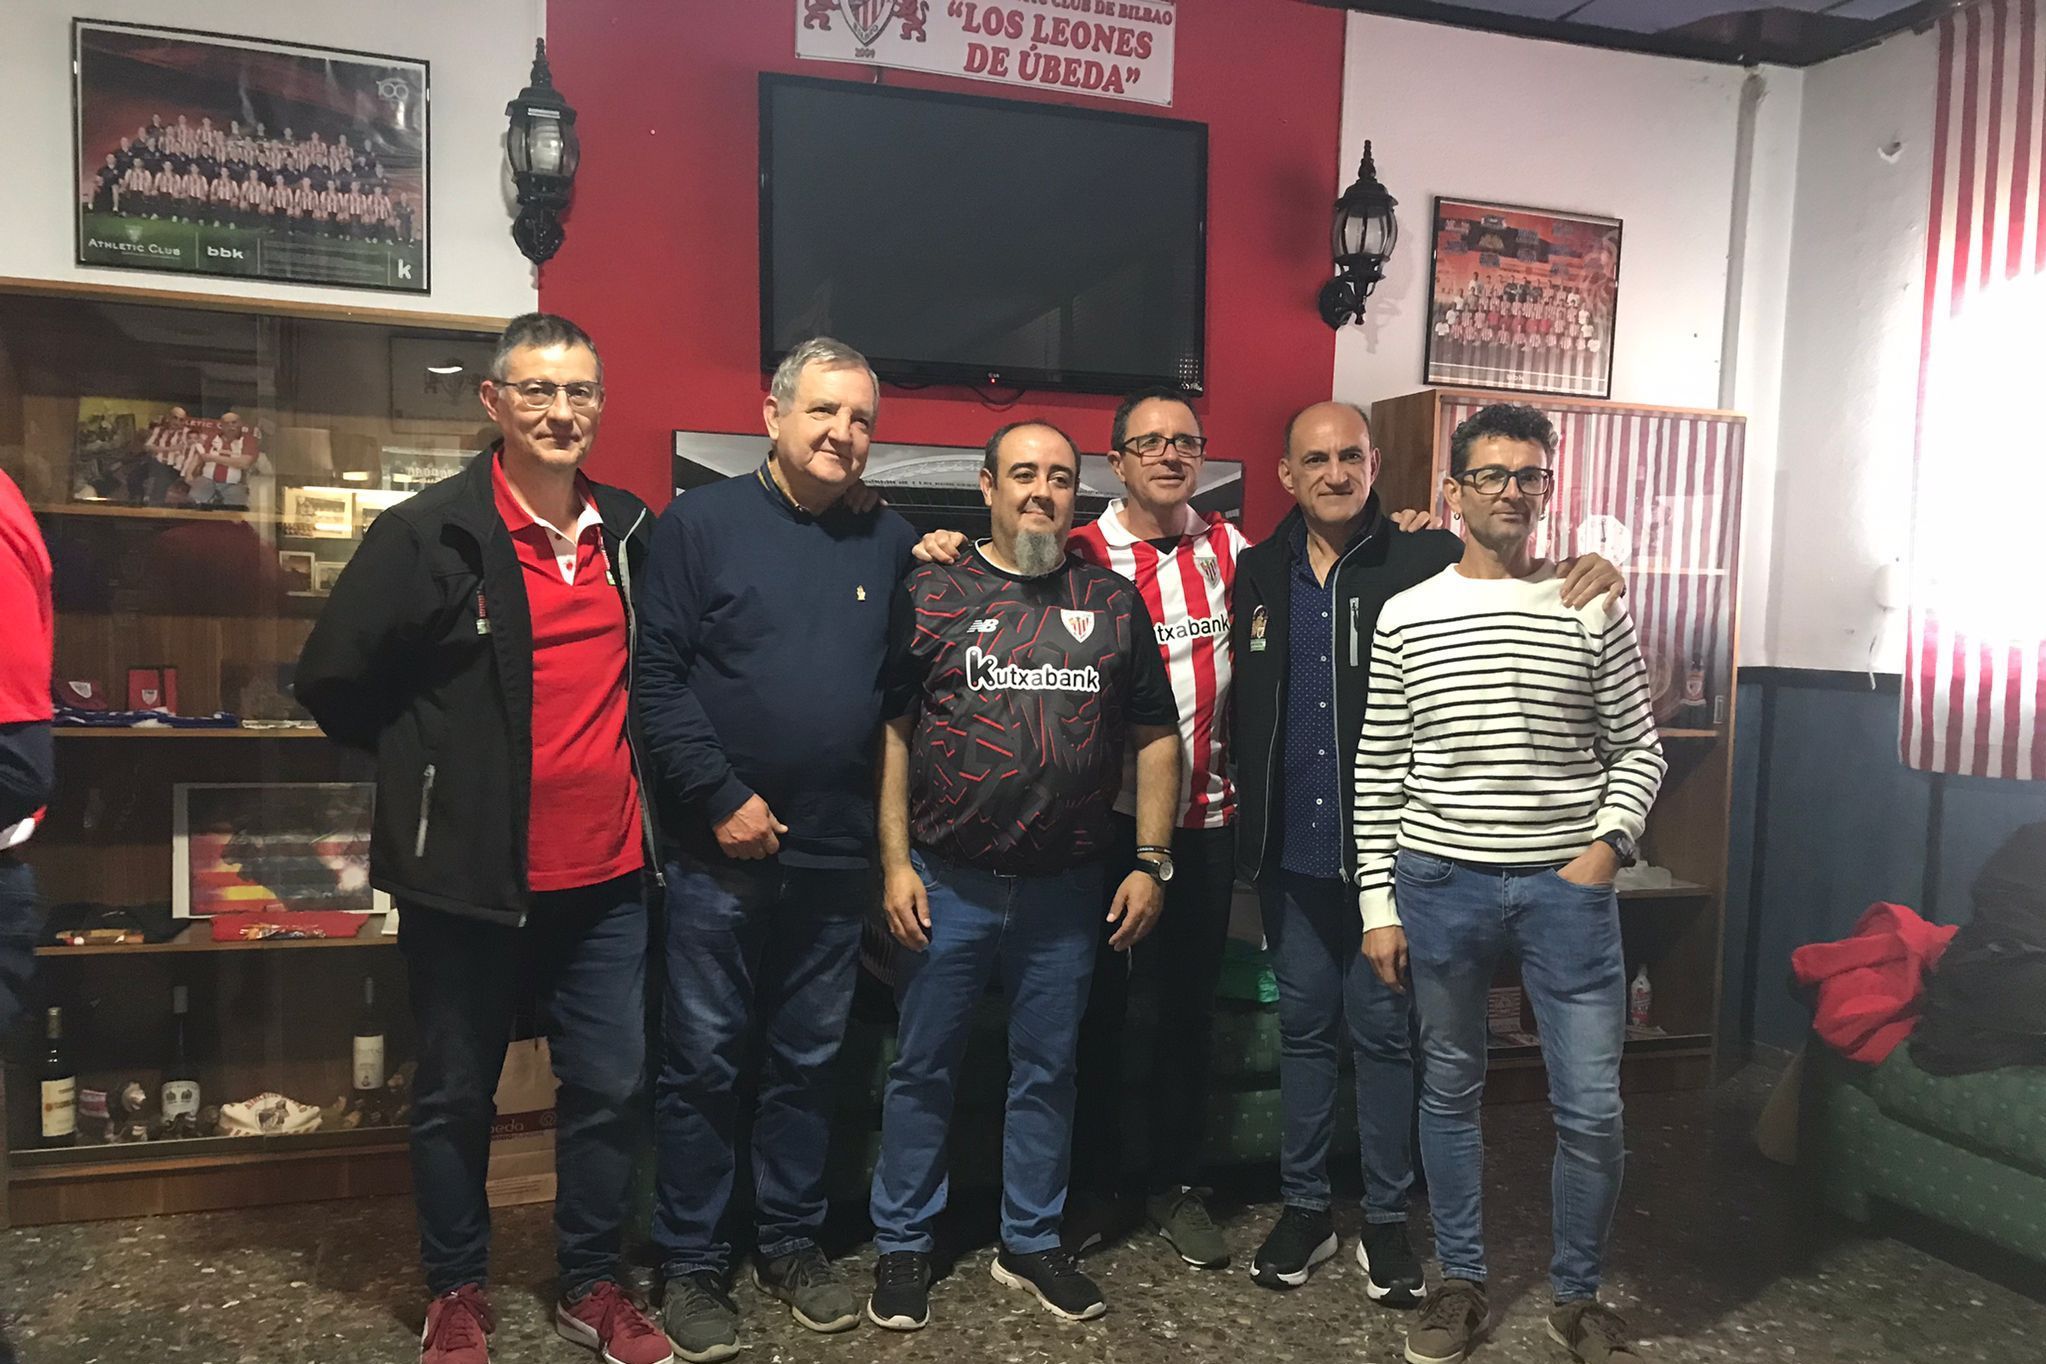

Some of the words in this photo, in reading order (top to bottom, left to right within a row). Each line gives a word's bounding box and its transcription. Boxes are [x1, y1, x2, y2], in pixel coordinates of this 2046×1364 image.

[1094, 1, 1115, 16] DE
[1118, 4, 1173, 25] BILBAO
[1031, 14, 1153, 59] LEONES
[964, 42, 1010, 77] DE
[88, 238, 145, 252] ATHLETIC
[148, 243, 181, 256] CLUB
[207, 246, 244, 259] bbk
[1157, 614, 1230, 641] txabank
[967, 647, 1100, 691] Kutxabank
